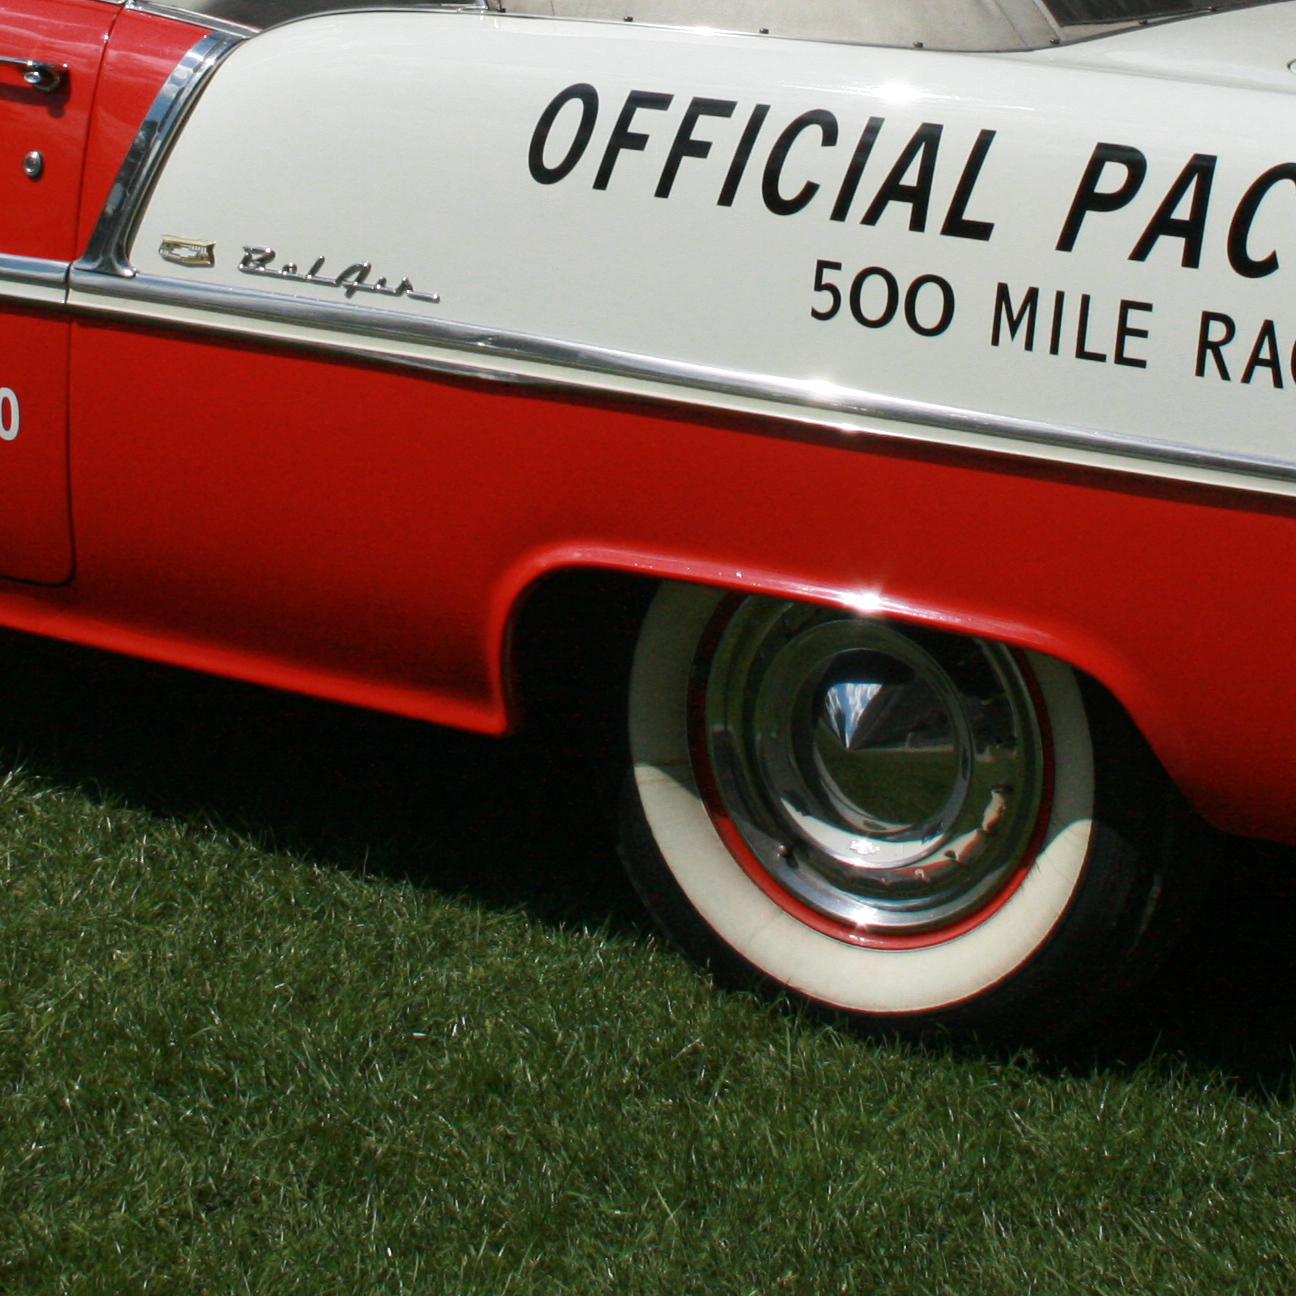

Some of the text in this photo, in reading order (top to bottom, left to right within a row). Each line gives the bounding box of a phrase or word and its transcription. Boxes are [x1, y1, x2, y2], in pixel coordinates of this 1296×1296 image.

[528, 83, 997, 242] OFFICIAL
[810, 259, 956, 337] 500
[990, 281, 1154, 369] MILE
